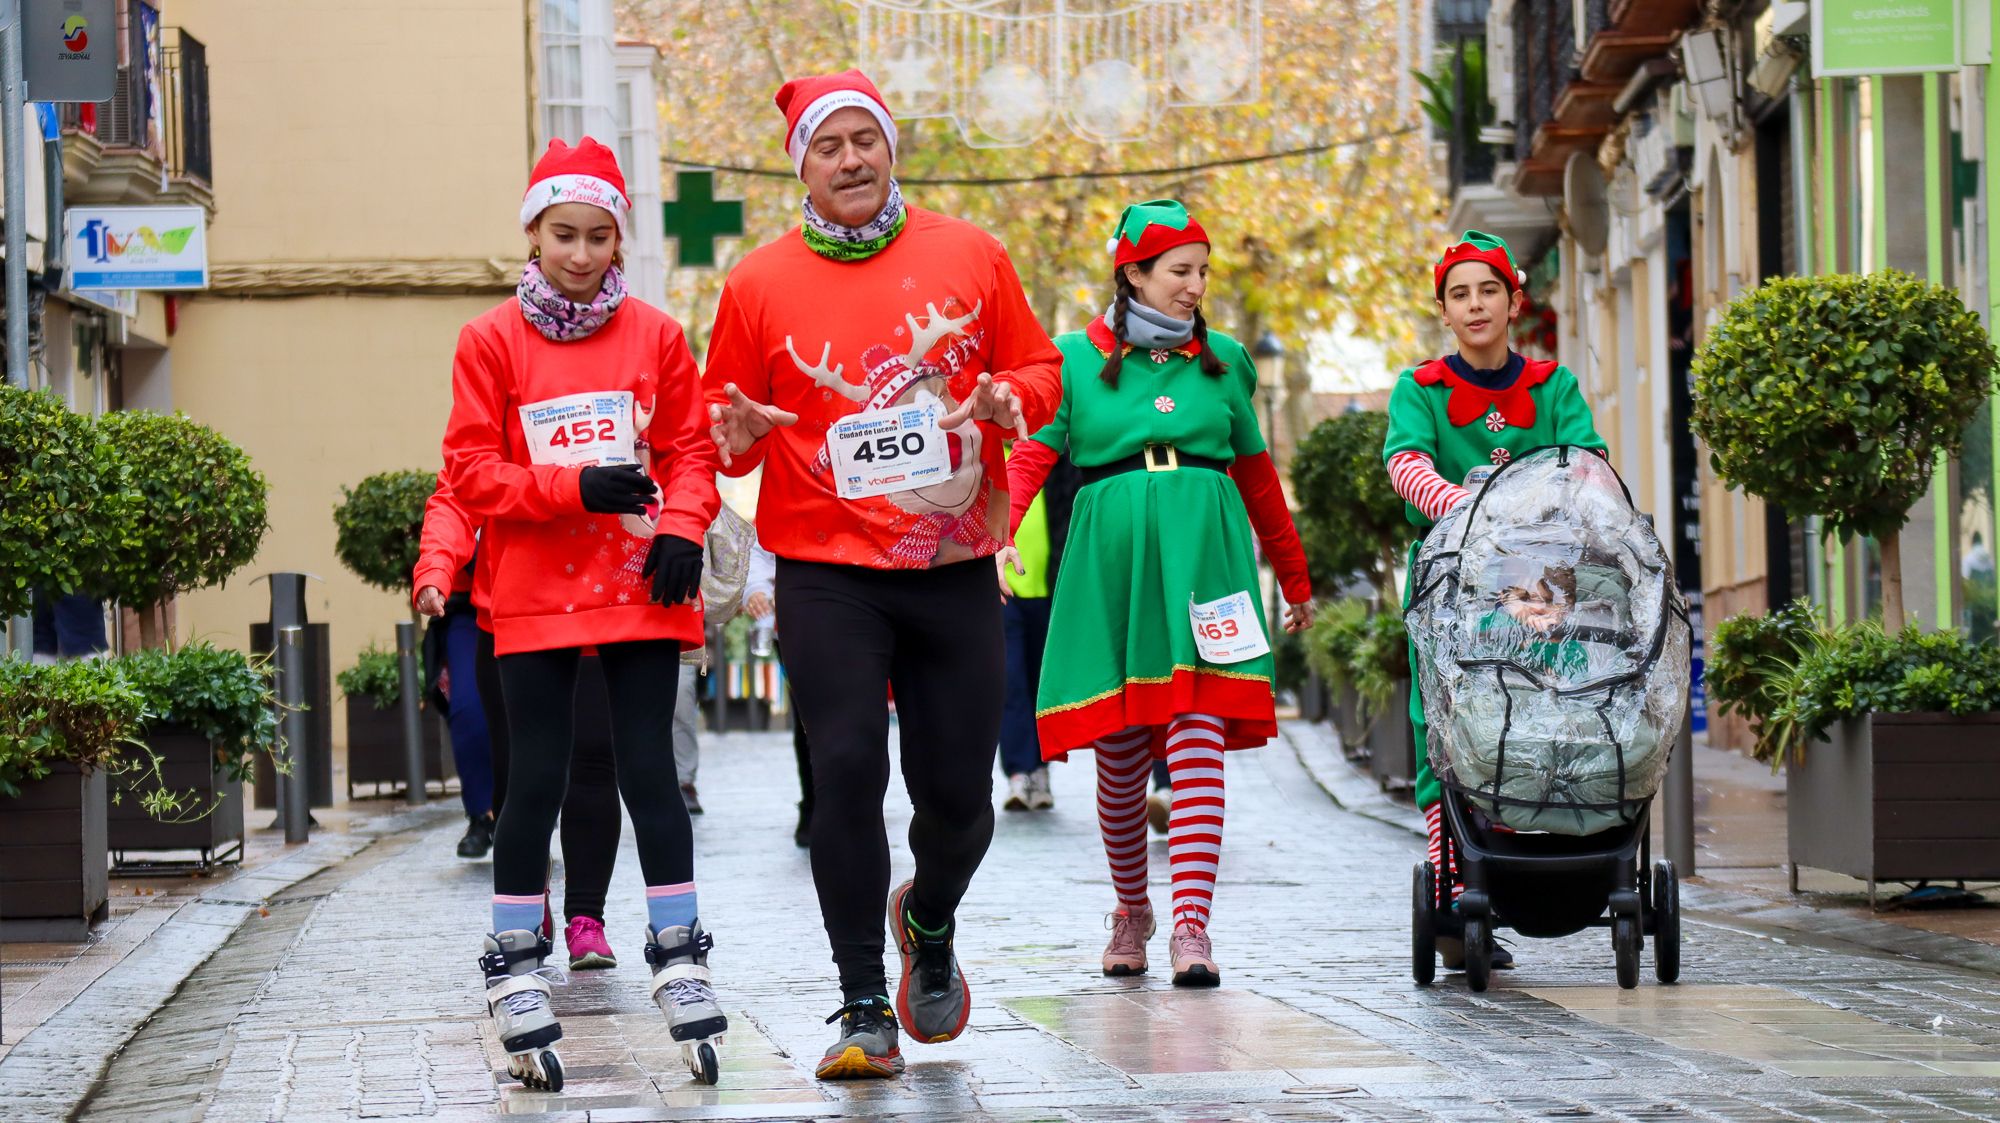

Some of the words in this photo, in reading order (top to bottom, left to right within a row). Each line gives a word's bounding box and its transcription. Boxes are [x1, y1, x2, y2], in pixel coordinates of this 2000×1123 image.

[532, 411, 546, 419] San
[546, 405, 576, 416] Silvestre
[533, 416, 557, 426] Ciudad
[557, 414, 567, 422] de
[567, 410, 592, 419] Lucena
[549, 418, 617, 448] 452
[839, 425, 852, 433] San
[852, 420, 883, 431] Silvestre
[839, 430, 863, 440] Ciudad
[864, 427, 873, 436] de
[874, 425, 898, 434] Lucena
[853, 432, 925, 463] 450
[911, 466, 940, 477] enerplus
[1198, 619, 1239, 640] 463
